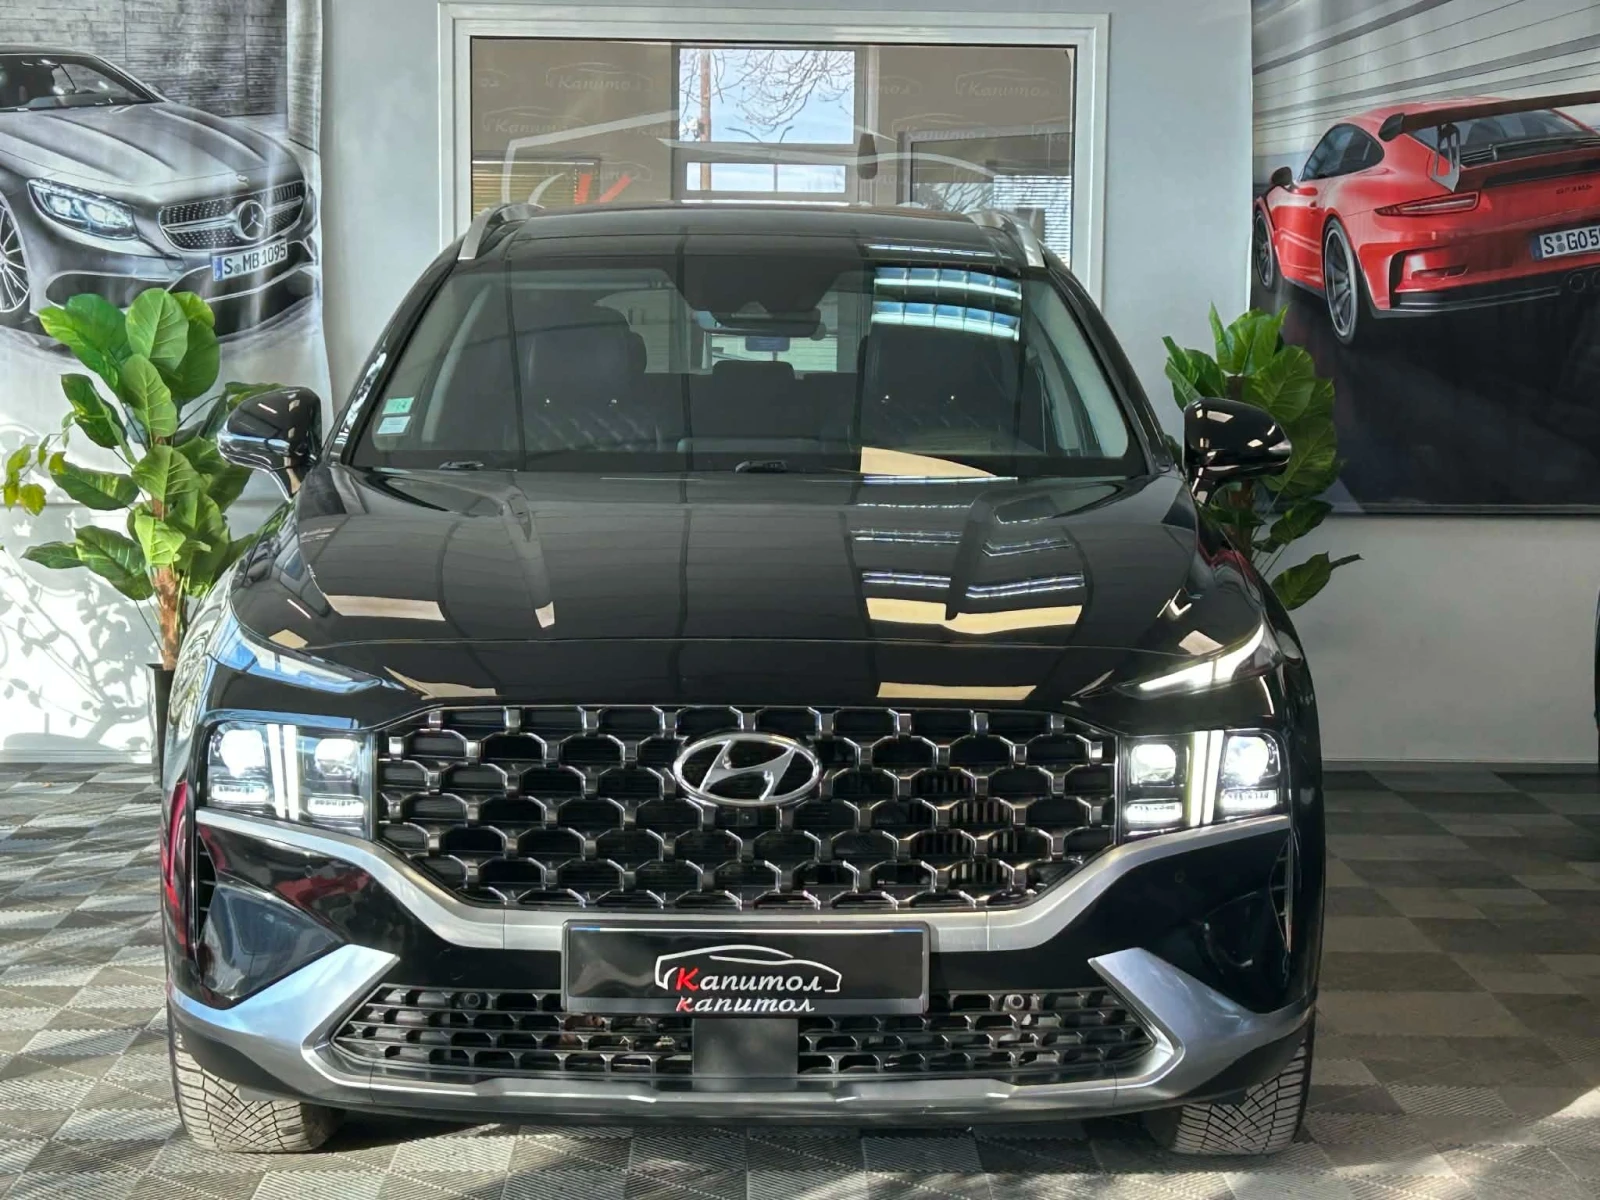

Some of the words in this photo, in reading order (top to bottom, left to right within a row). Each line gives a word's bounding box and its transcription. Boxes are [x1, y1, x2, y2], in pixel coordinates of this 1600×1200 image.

[1544, 236, 1555, 254] S
[224, 258, 233, 275] S
[243, 252, 259, 271] MB
[262, 243, 286, 265] 1095
[675, 967, 822, 992] Капитол
